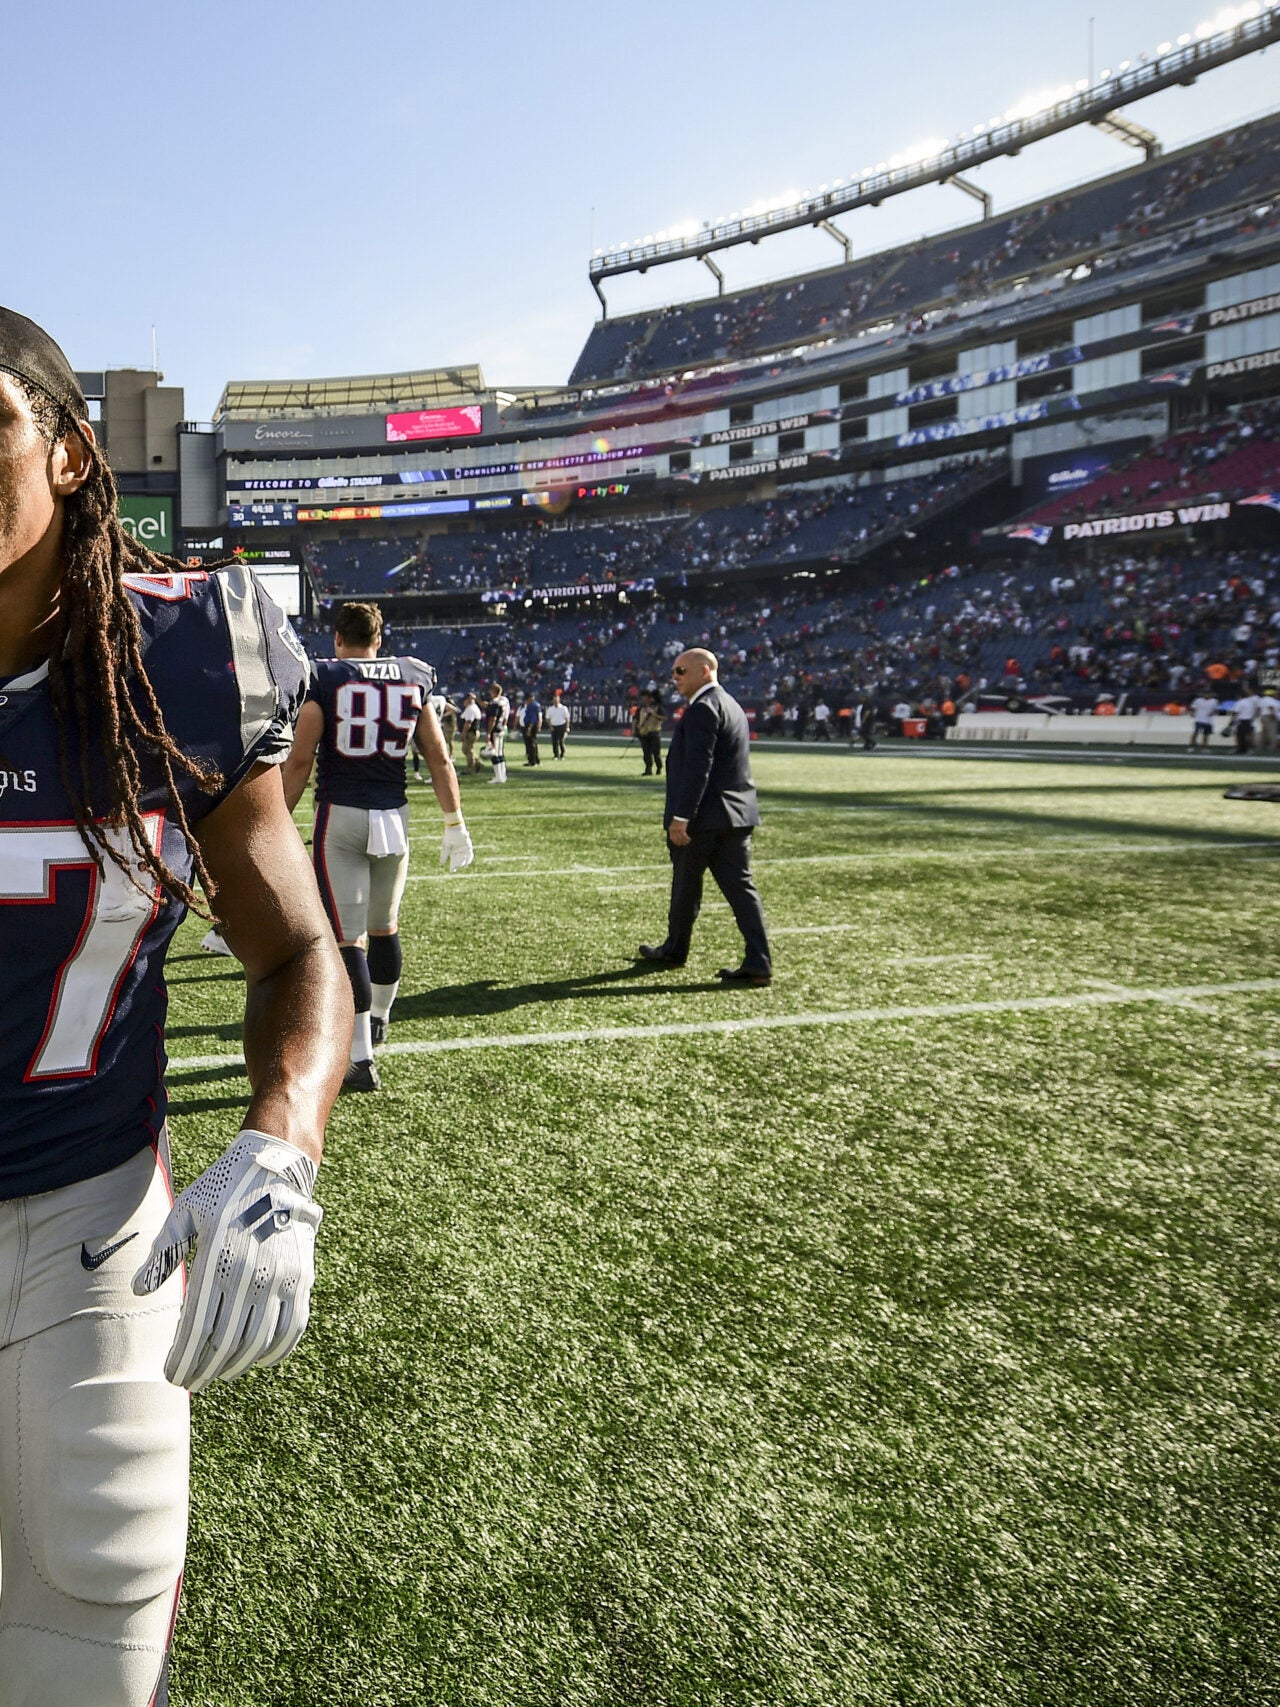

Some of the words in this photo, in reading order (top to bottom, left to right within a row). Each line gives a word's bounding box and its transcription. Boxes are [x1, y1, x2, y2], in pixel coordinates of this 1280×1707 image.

[255, 425, 312, 439] Encore
[711, 422, 777, 443] PATRIOTS
[779, 415, 809, 430] WIN
[463, 467, 507, 476] DOWNLOAD
[509, 464, 524, 473] THE
[527, 460, 545, 470] NEW
[547, 456, 584, 468] GILLETTE
[587, 450, 624, 463] STADIUM
[627, 447, 643, 457] APP
[709, 460, 776, 481] PATRIOTS
[779, 455, 808, 469] WIN
[245, 480, 293, 489] WELCOME
[298, 480, 312, 488] TO
[1048, 468, 1089, 484] Gillette
[232, 513, 244, 521] 30
[1064, 511, 1174, 540] PATRIOTS
[1178, 503, 1231, 525] WIN
[532, 585, 590, 599] PATRIOTS
[592, 583, 617, 594] WIN
[336, 681, 422, 759] 85
